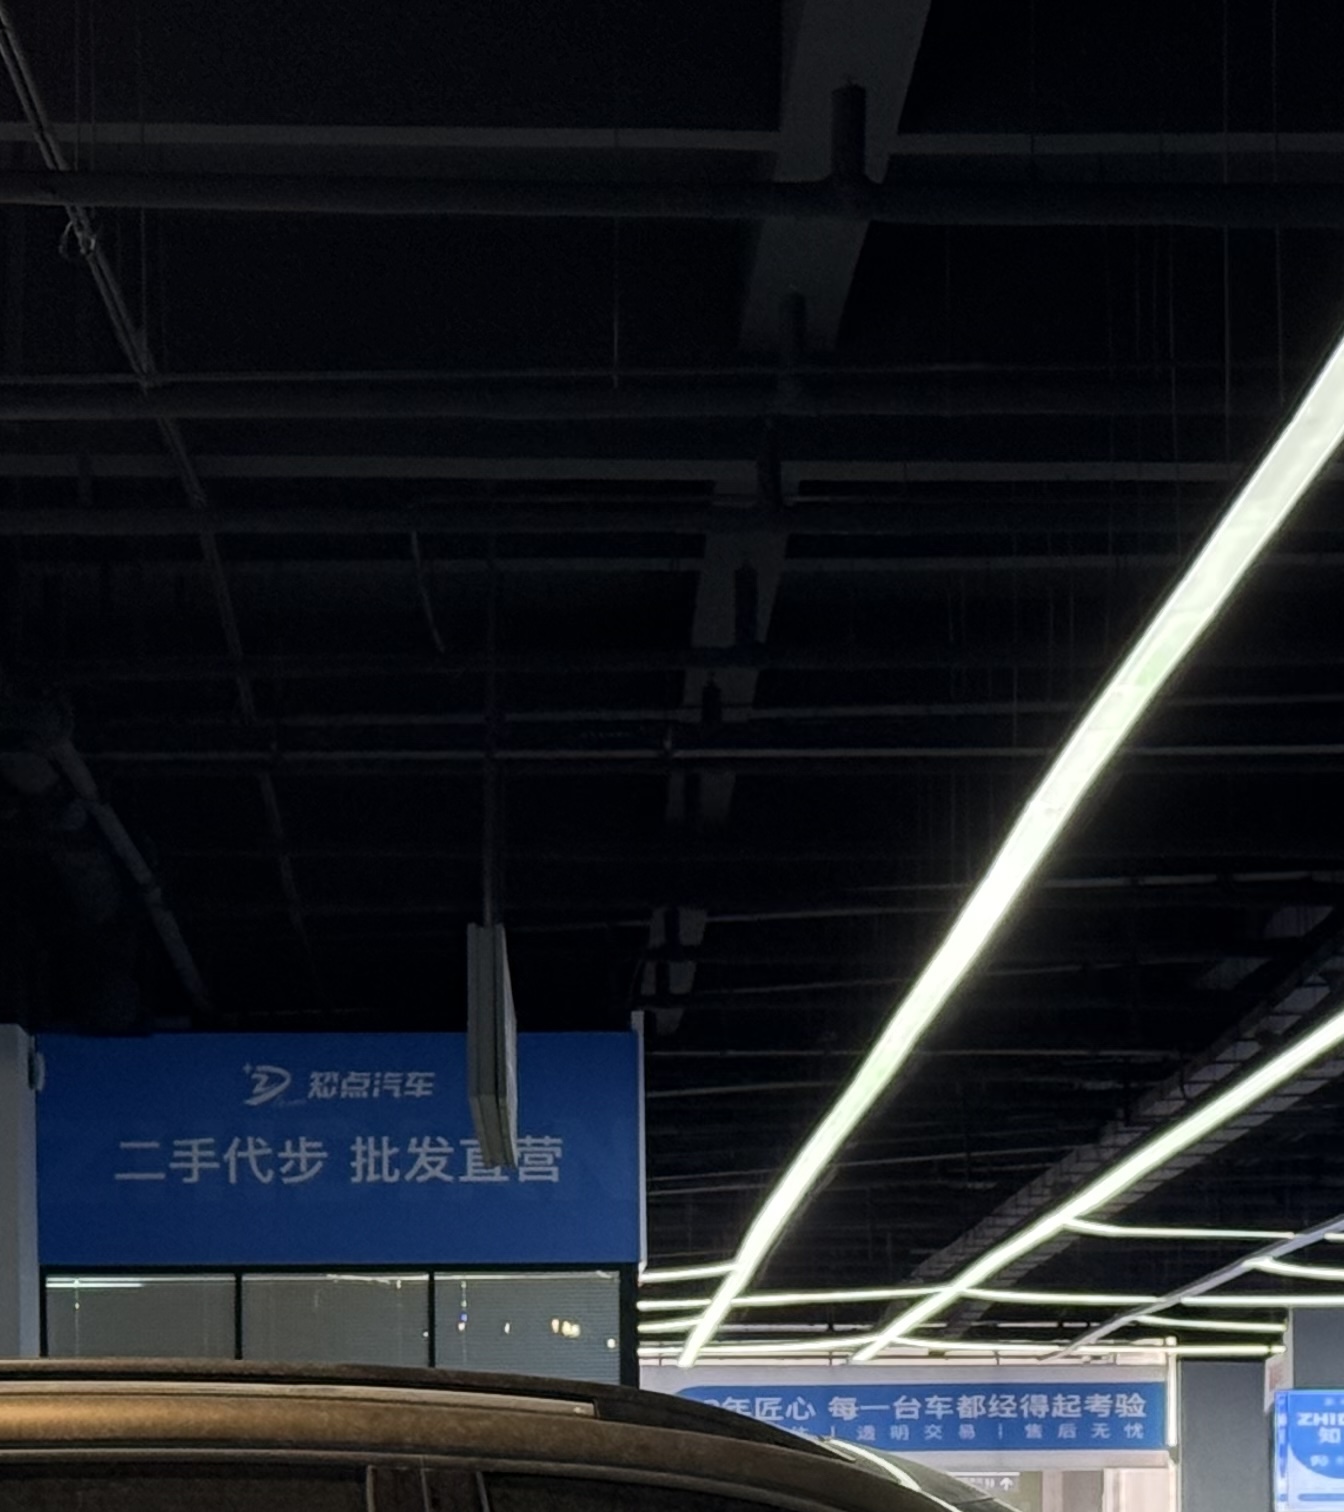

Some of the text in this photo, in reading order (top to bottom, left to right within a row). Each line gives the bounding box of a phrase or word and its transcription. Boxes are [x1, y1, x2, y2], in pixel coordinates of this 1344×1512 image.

[114, 1136, 329, 1184] 二手代步
[827, 1393, 1148, 1422] 每一台车都经得起考验
